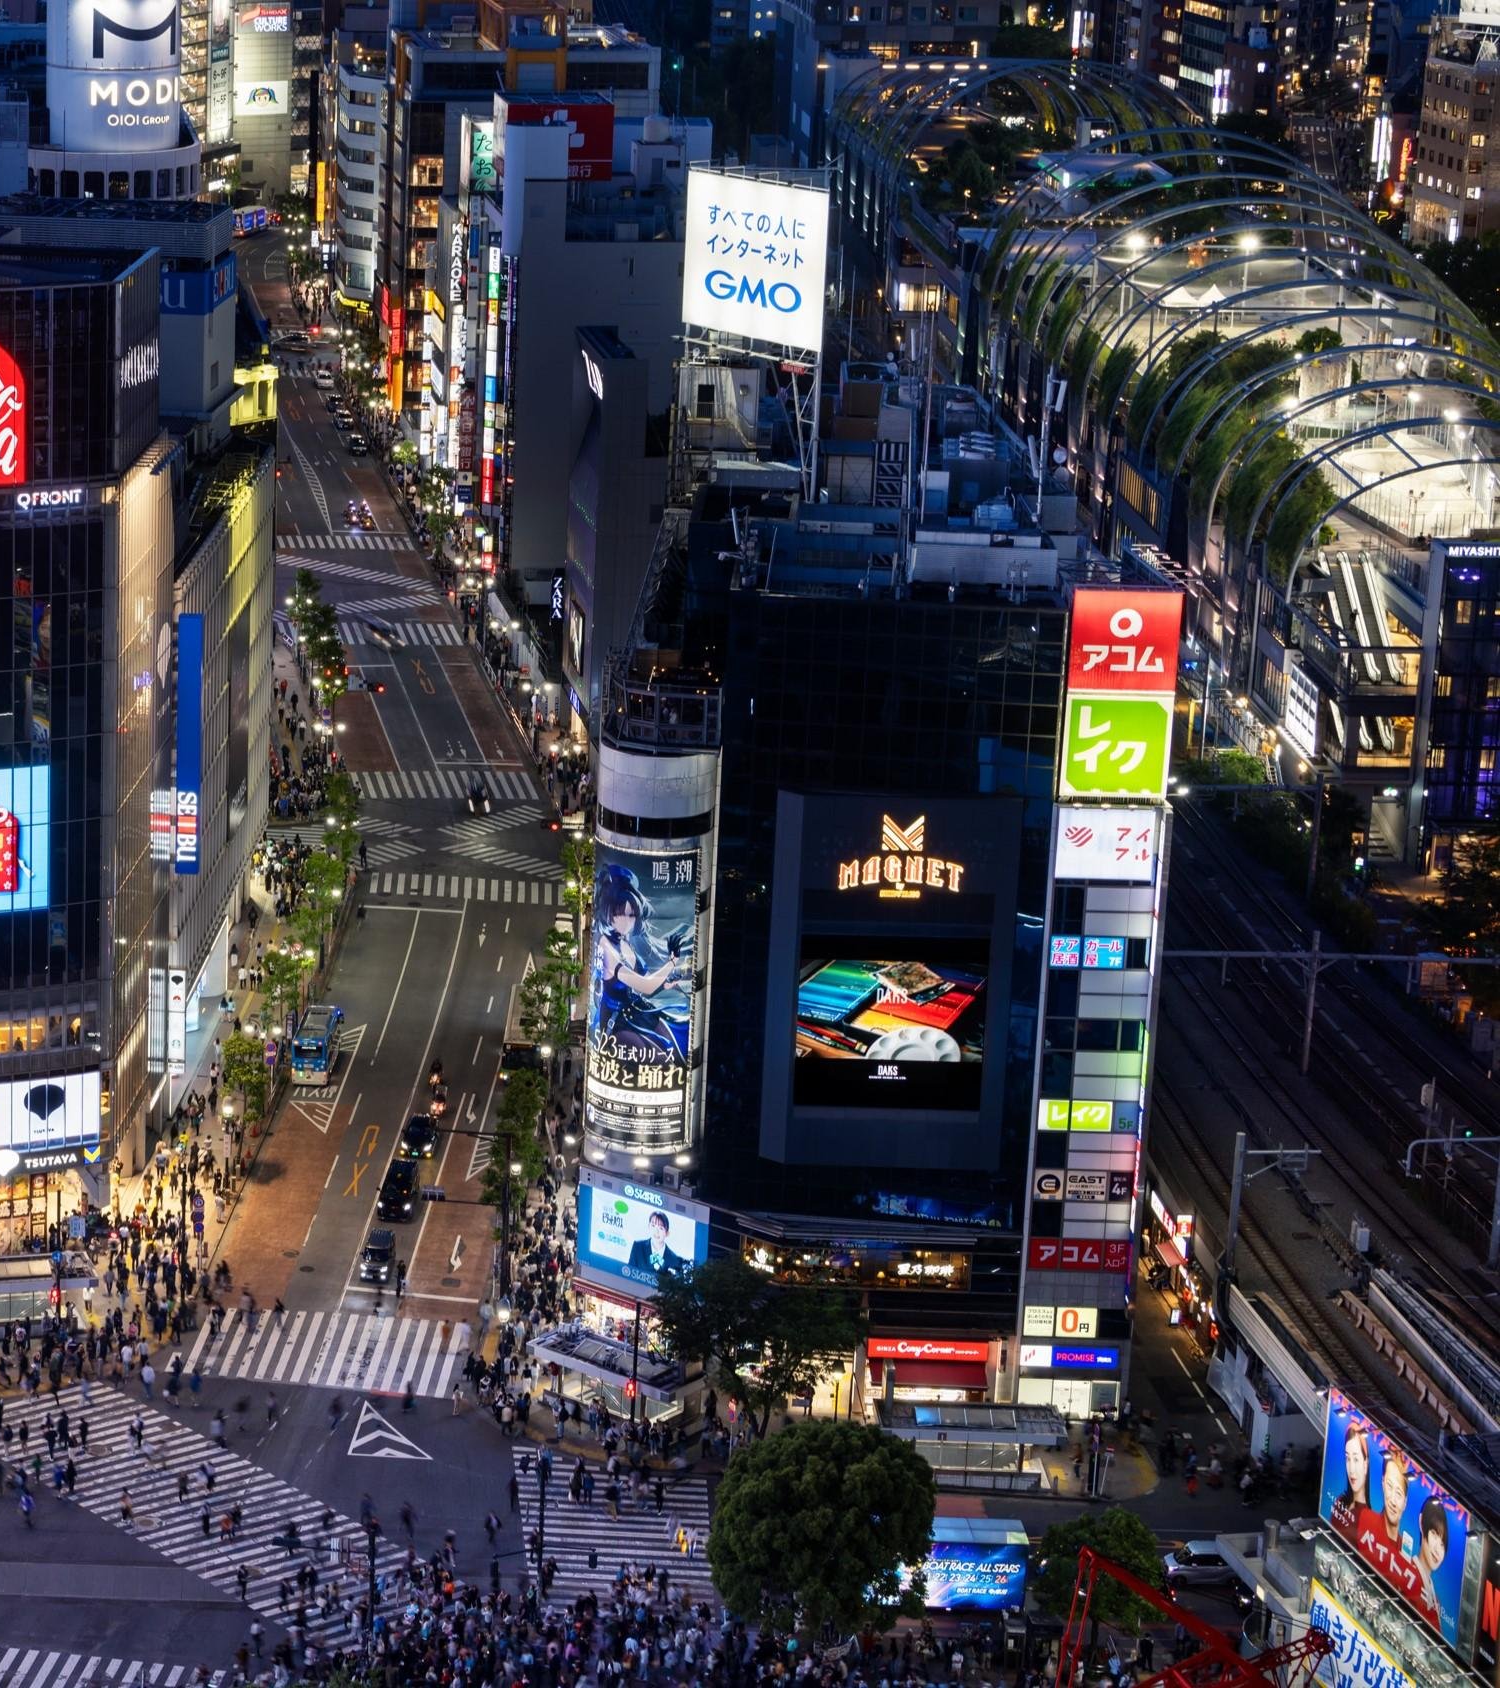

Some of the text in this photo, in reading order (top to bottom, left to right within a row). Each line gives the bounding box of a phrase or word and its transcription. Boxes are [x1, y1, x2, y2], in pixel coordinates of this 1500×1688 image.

[254, 16, 288, 25] CULTURE
[254, 24, 288, 32] WORKS
[90, 76, 179, 106] MODI
[708, 204, 806, 240] すべての人に
[707, 234, 804, 269] インターネット
[450, 223, 463, 301] KARAOKE
[705, 270, 802, 313] GMO
[553, 577, 563, 619] ZARA
[1082, 645, 1165, 673] アコム
[177, 791, 198, 862] SEIBU
[652, 859, 693, 886] 鳴潮
[838, 854, 965, 893] MAGNET
[1052, 939, 1124, 952] チアガール
[1051, 953, 1122, 967] 居酒屋 7F
[876, 986, 908, 1005] DAKS
[878, 1065, 898, 1076] DAKS
[1052, 1105, 1134, 1130] レイク 5F
[25, 1153, 78, 1168] TSUTAYA
[1068, 1176, 1106, 1184] EAST
[1112, 1182, 1127, 1195] 4F
[1039, 1245, 1100, 1264] アコム
[1109, 1243, 1125, 1254] 3F
[749, 1259, 775, 1274] COFFEE
[1056, 1352, 1095, 1363] PROMISE
[975, 1562, 992, 1572] ALL
[992, 1563, 1021, 1574] STARS
[1360, 1528, 1417, 1590] ペイトク
